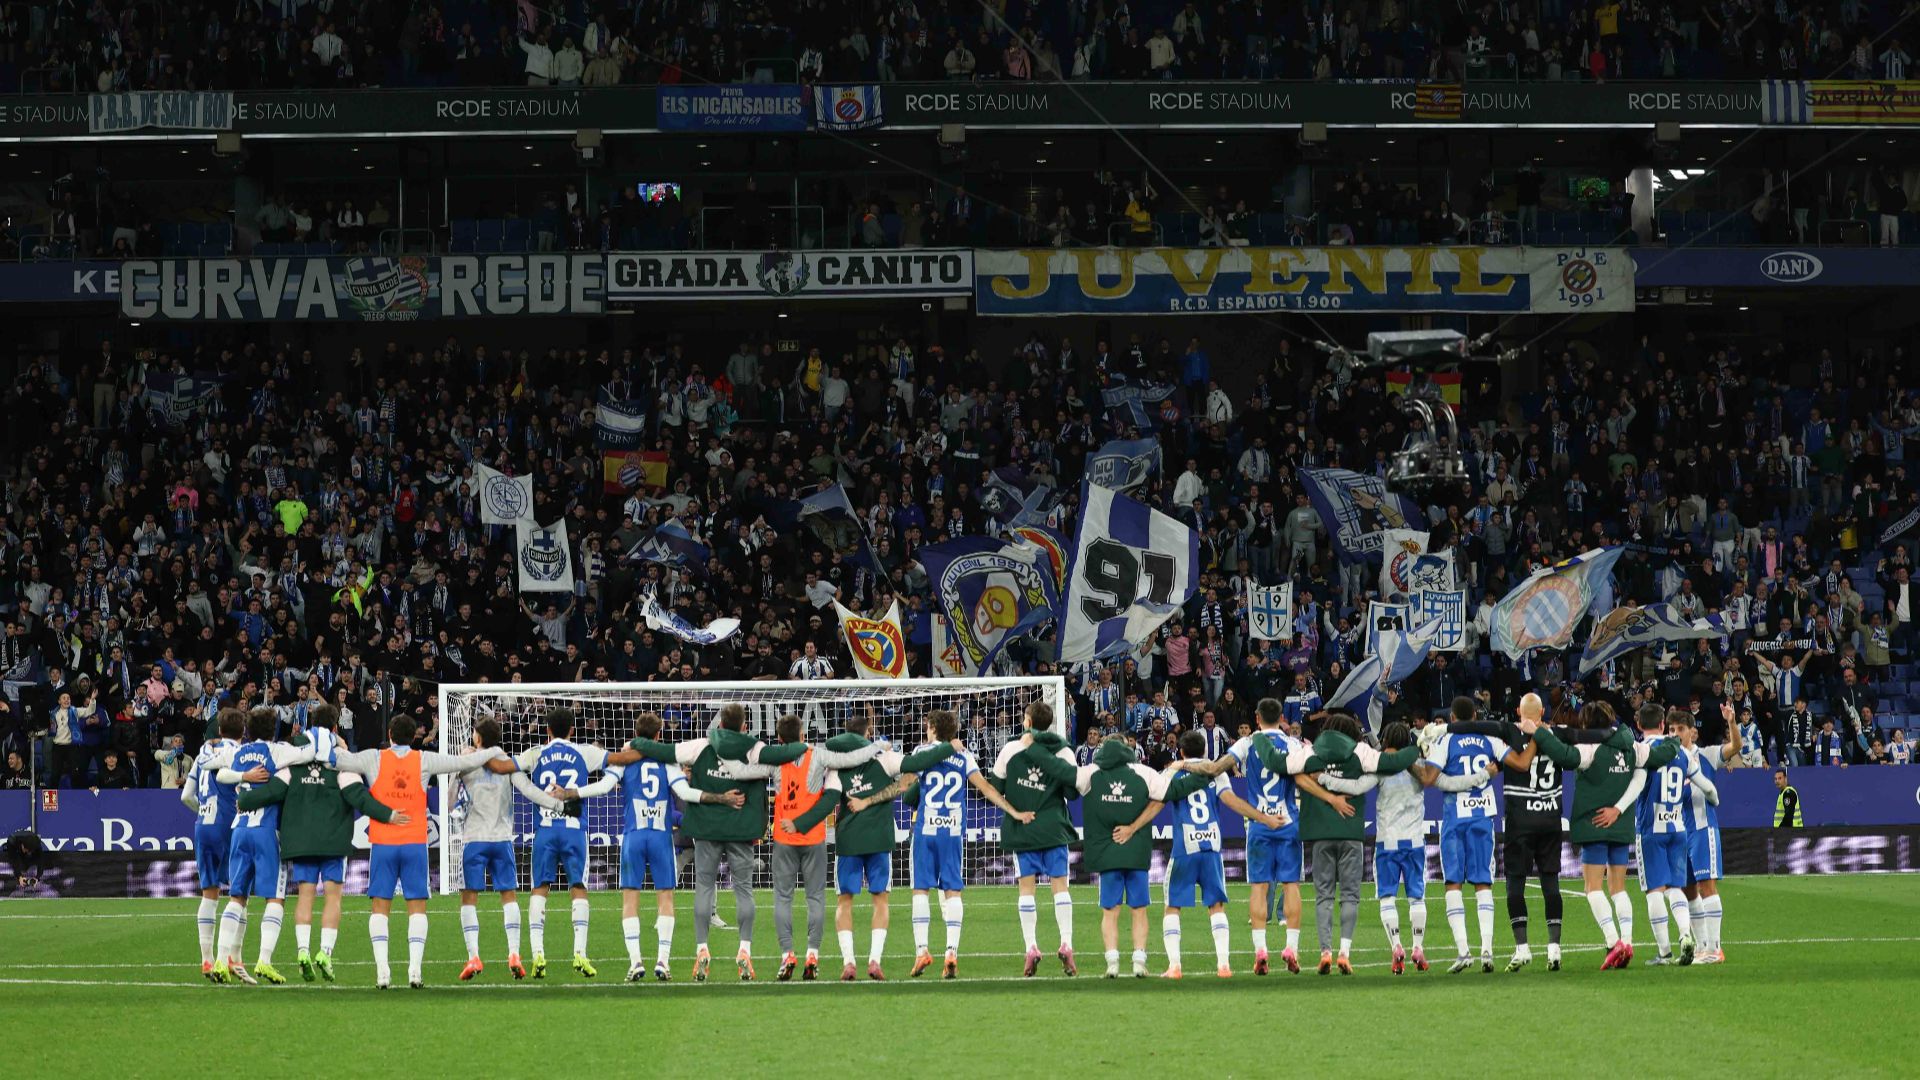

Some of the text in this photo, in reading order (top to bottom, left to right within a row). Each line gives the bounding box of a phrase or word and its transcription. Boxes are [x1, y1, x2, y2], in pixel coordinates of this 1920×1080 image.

[436, 99, 580, 118] RCDE STADIUM
[661, 95, 802, 115] ELS INCANSABLES
[906, 94, 1048, 111] RCDE STADIUM
[1149, 93, 1291, 110] RCDE STADIUM
[1391, 93, 1531, 110] RC TADIUM
[1628, 92, 1681, 110] RCDE
[255, 102, 336, 120] STADIUM
[614, 255, 962, 288] GRADA CANITO
[990, 247, 1516, 299] JUVENIL
[1767, 259, 1809, 276] DANI
[120, 258, 339, 319] CURVA
[440, 255, 603, 316] RCDE
[1170, 297, 1210, 311] R.C.D.
[1558, 288, 1606, 307] 1991
[988, 557, 1025, 572] 1991
[1081, 537, 1176, 624] 91
[1424, 592, 1462, 602] JUVENIL
[1458, 736, 1485, 749] PICKEL
[540, 752, 577, 766] EL HILALI
[301, 776, 326, 785] KELME
[640, 762, 660, 799] 5
[1529, 755, 1555, 790] 13
[924, 771, 963, 809] 22
[1017, 777, 1047, 791] KELME
[1260, 767, 1280, 803] 2
[1657, 765, 1684, 803] 19
[1101, 794, 1133, 804] KELME
[1187, 789, 1210, 825] 8
